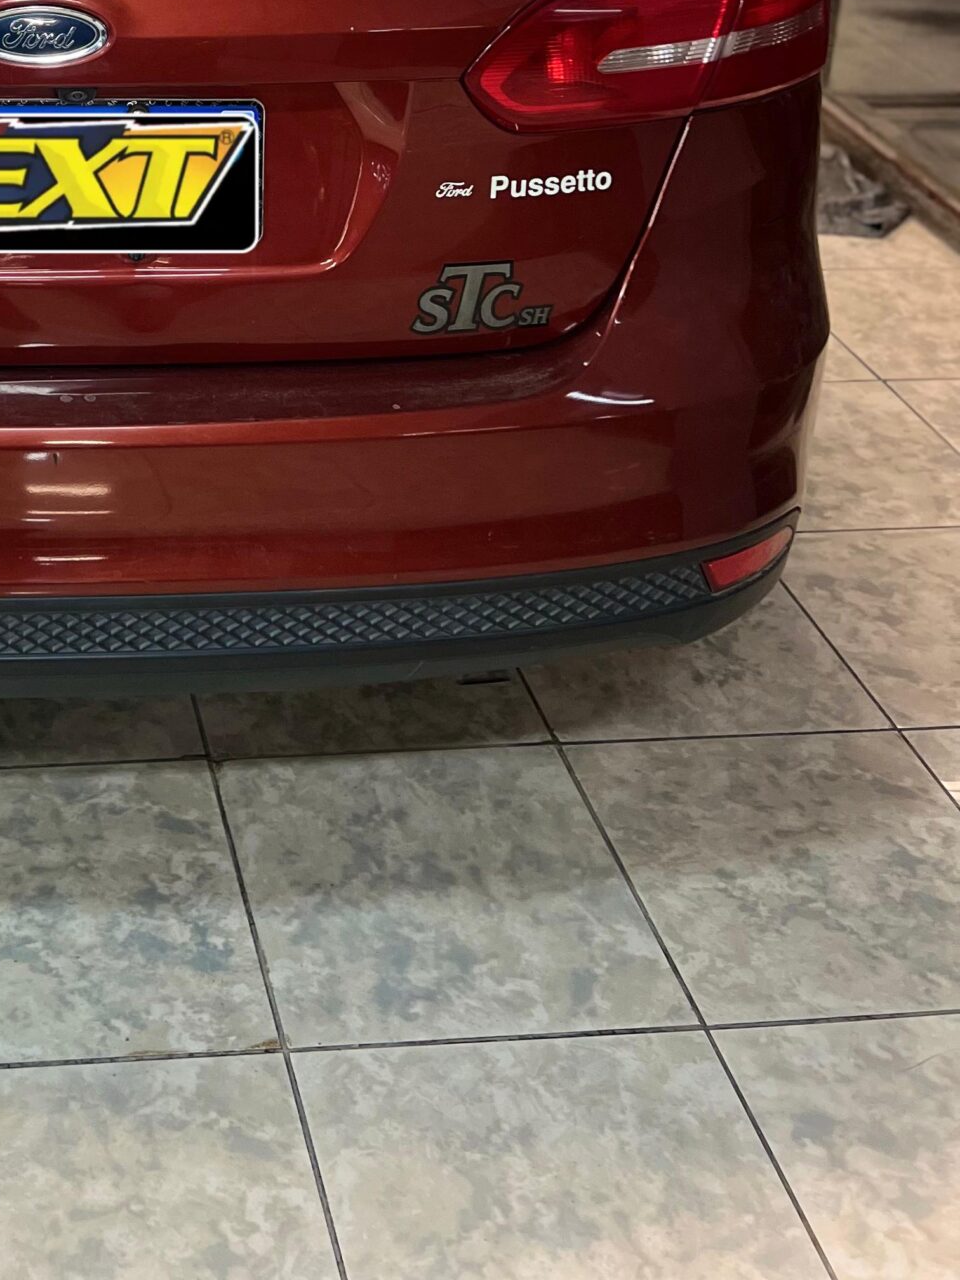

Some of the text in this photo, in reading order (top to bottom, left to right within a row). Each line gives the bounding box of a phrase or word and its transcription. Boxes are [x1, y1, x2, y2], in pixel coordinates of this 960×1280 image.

[1, 17, 77, 49] Ford
[434, 169, 613, 200] Ford Pussetto
